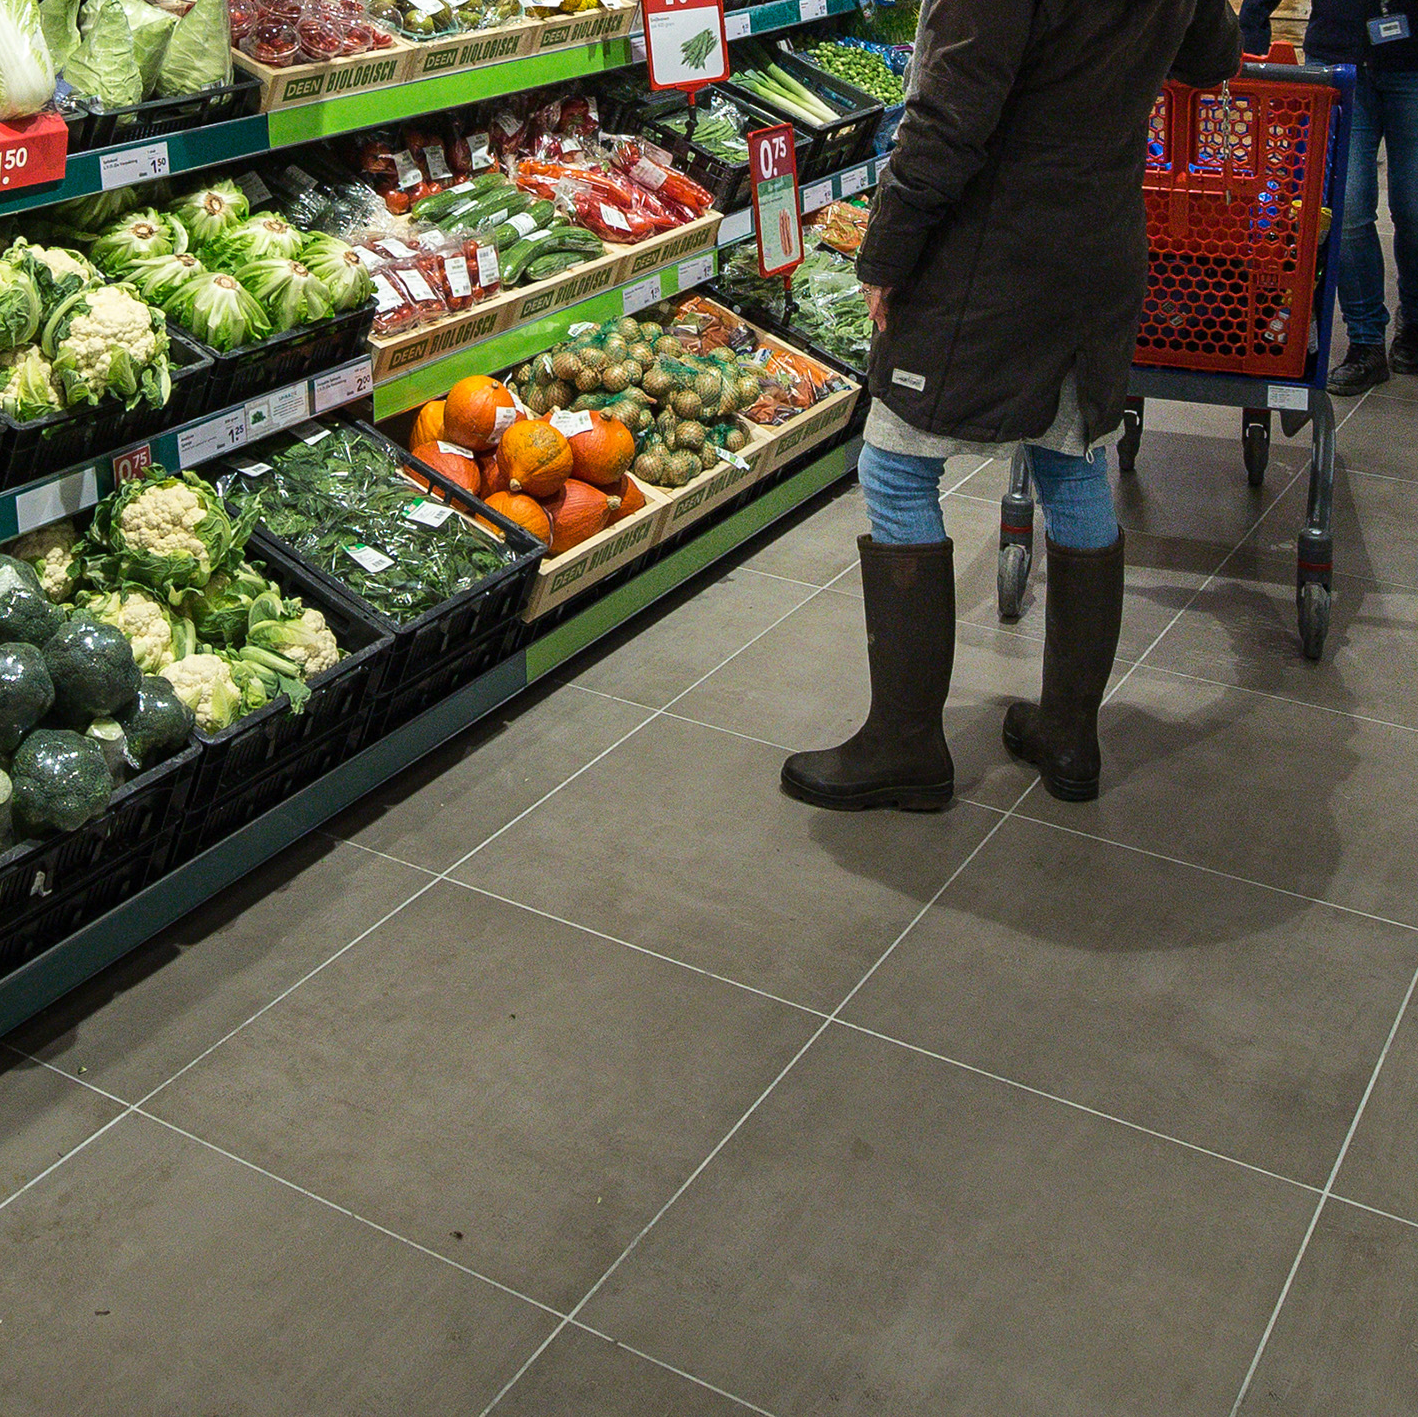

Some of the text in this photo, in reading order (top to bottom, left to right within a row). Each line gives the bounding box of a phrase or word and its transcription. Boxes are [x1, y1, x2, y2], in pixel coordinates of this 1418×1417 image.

[544, 14, 624, 44] DEEN BIOLOGISCH
[426, 35, 521, 68] DEEN BIOLOGISCH
[287, 60, 398, 96] DEEN BIOLOGISCH
[151, 158, 165, 173] 1.50
[759, 136, 786, 179] 0.75
[661, 228, 712, 261] BIOLOGISCH
[525, 295, 551, 312] DEEN
[554, 268, 612, 305] BIOLOGISCH
[394, 313, 498, 363] DEEN BIOLOGISCH
[357, 375, 371, 391] 2.00
[228, 425, 244, 442] 1.25
[119, 452, 147, 481] 0.75
[555, 519, 653, 589] DEEN BIOLOGISCH
